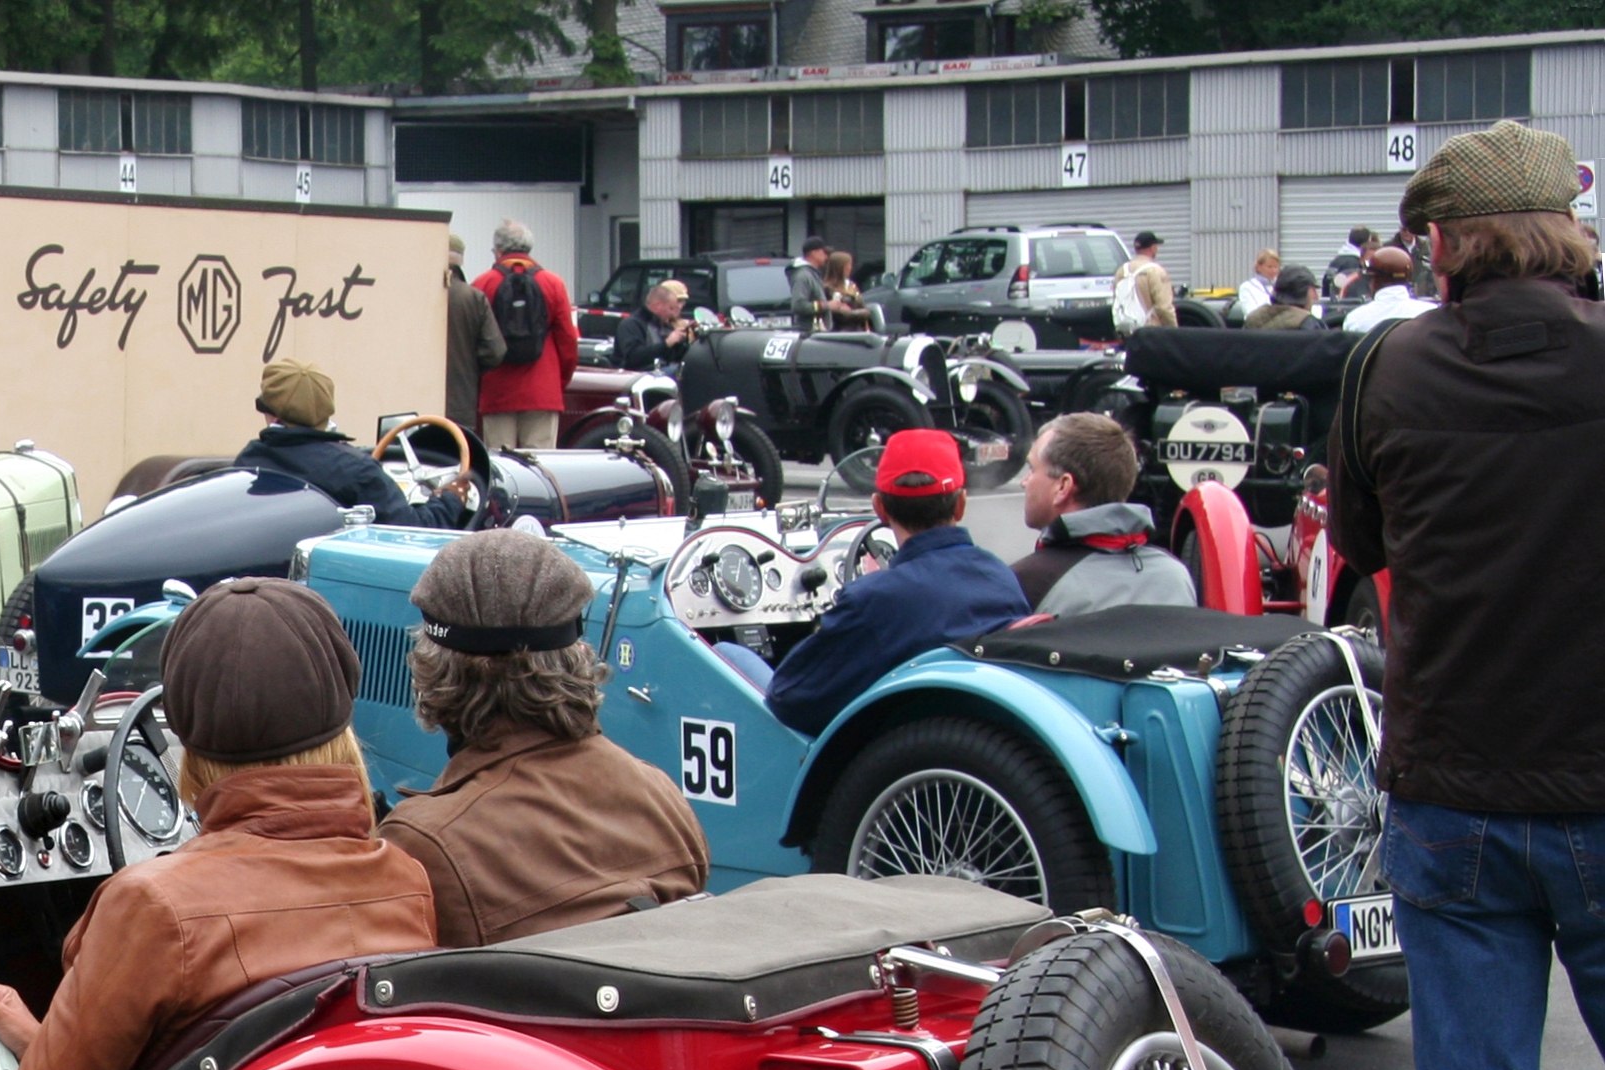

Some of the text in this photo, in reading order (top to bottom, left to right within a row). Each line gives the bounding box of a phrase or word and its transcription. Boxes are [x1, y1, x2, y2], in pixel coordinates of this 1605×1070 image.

[1388, 134, 1415, 162] 48
[120, 162, 135, 188] 44
[769, 165, 791, 190] 46
[1063, 152, 1087, 179] 47
[297, 171, 310, 196] 45
[17, 243, 376, 364] Safety MG Fast
[766, 338, 790, 358] 54
[1166, 442, 1246, 462] OU 7794
[10, 651, 29, 670] LL
[682, 720, 735, 800] 59
[1351, 905, 1397, 951] NGM
